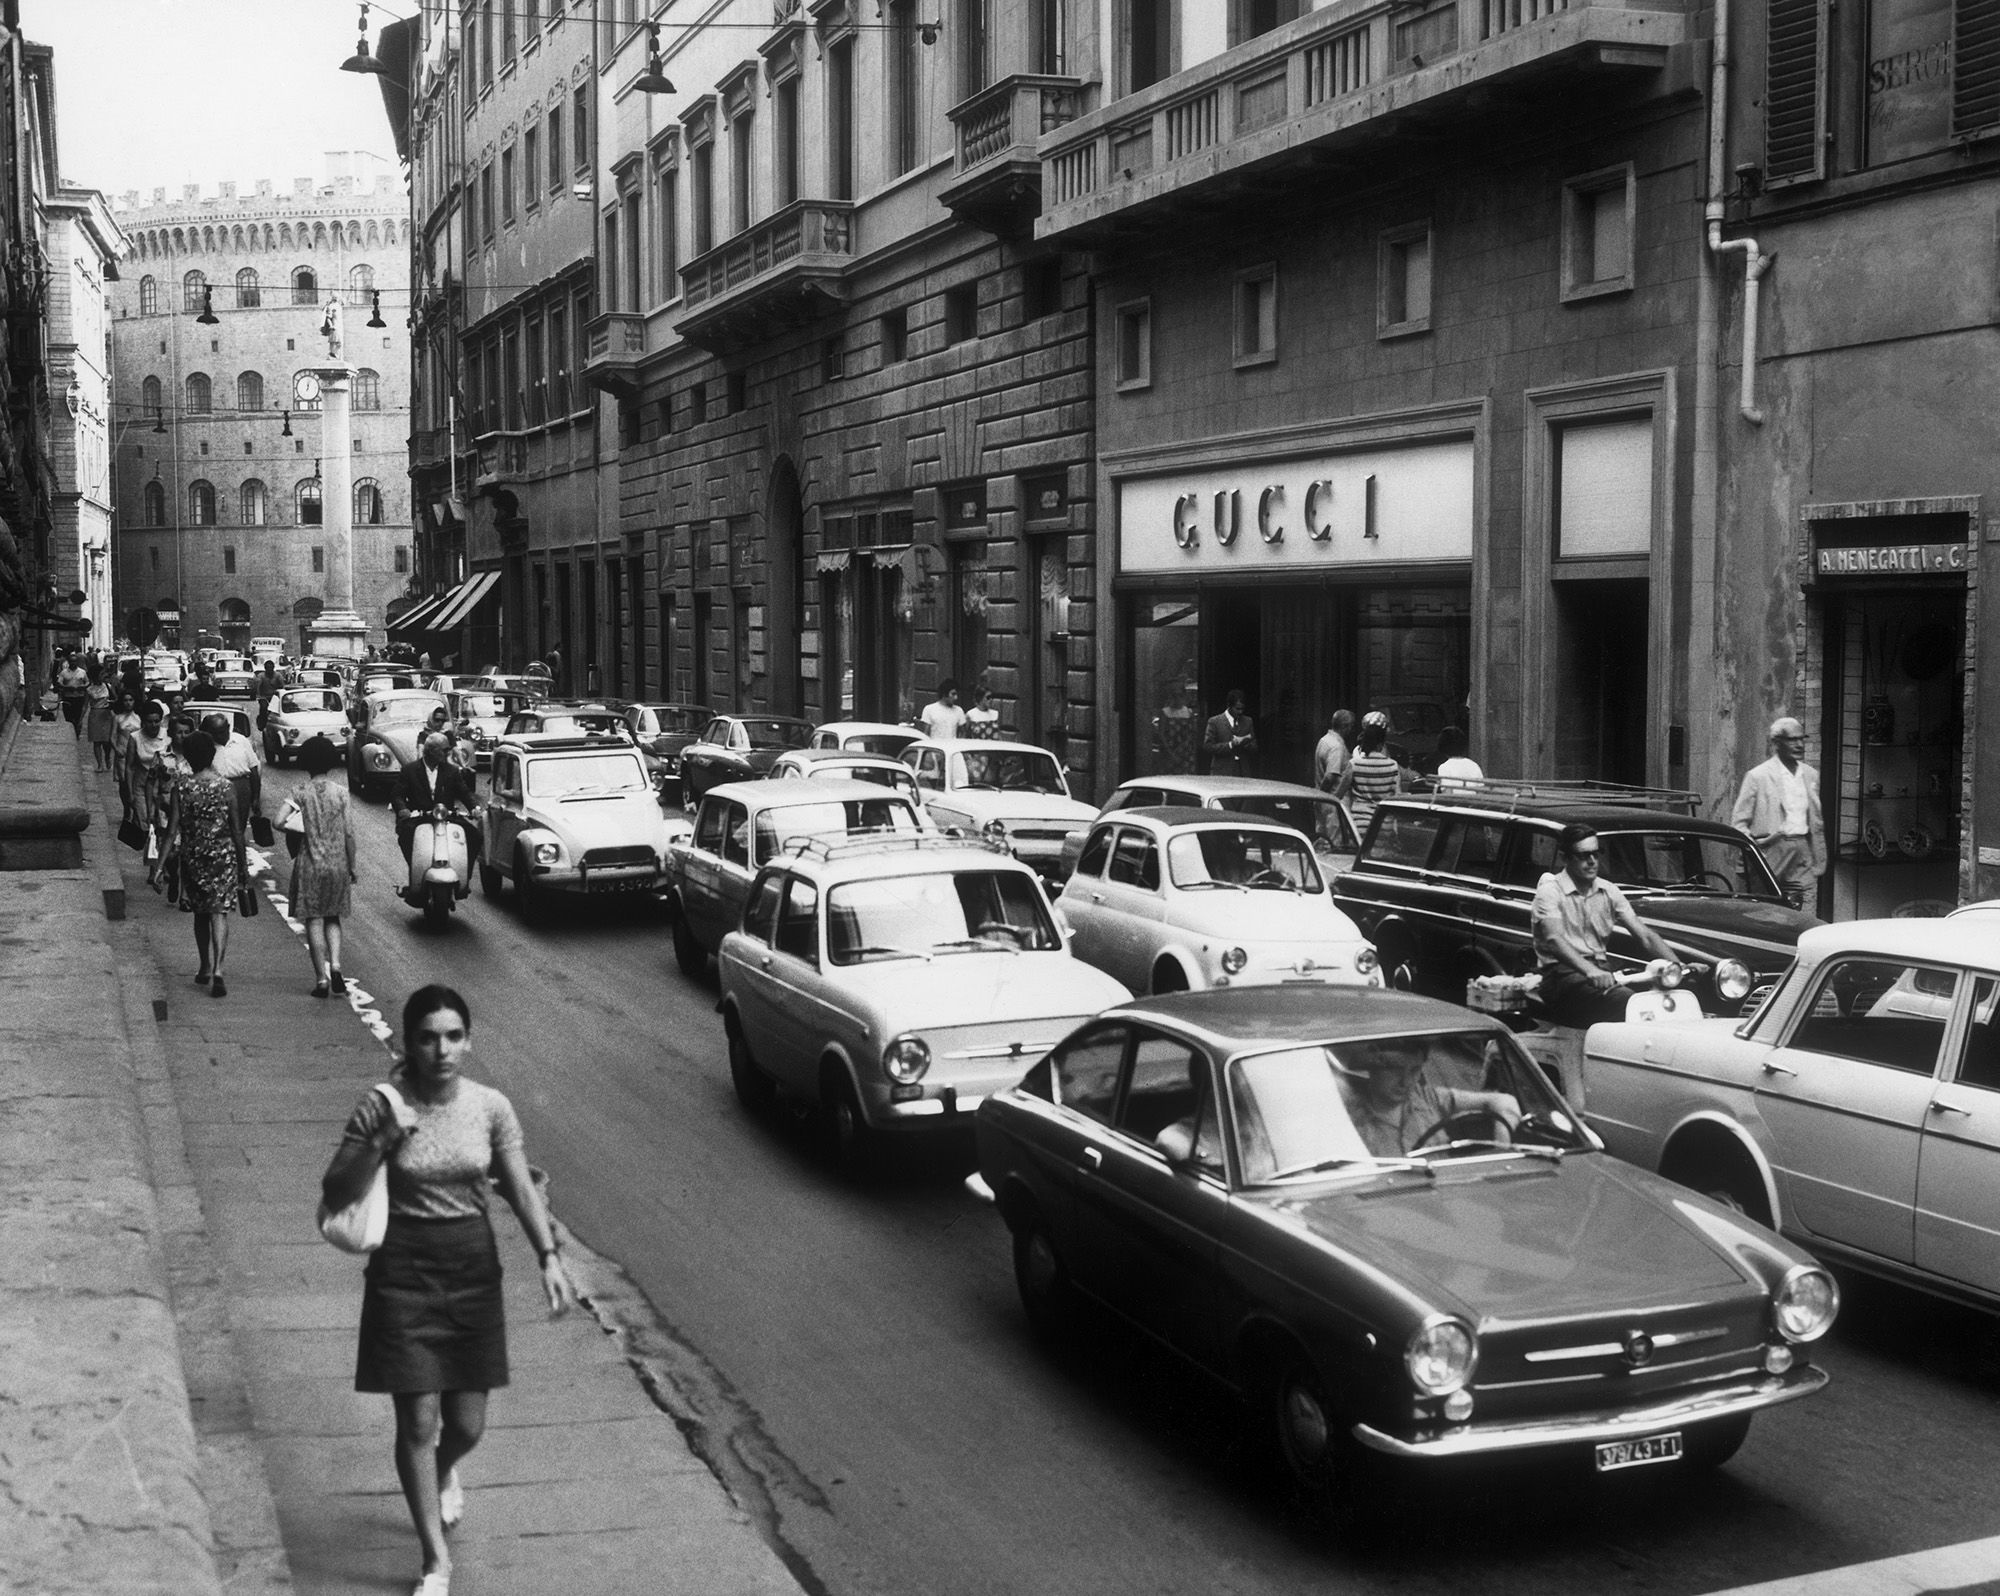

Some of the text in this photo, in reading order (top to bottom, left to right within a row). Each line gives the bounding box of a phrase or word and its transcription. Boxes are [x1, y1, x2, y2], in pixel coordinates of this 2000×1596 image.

[1173, 473, 1379, 550] GUCCI
[1820, 551, 1836, 571] A.
[1837, 547, 1927, 571] MENEGATTI
[1934, 556, 1943, 568] e
